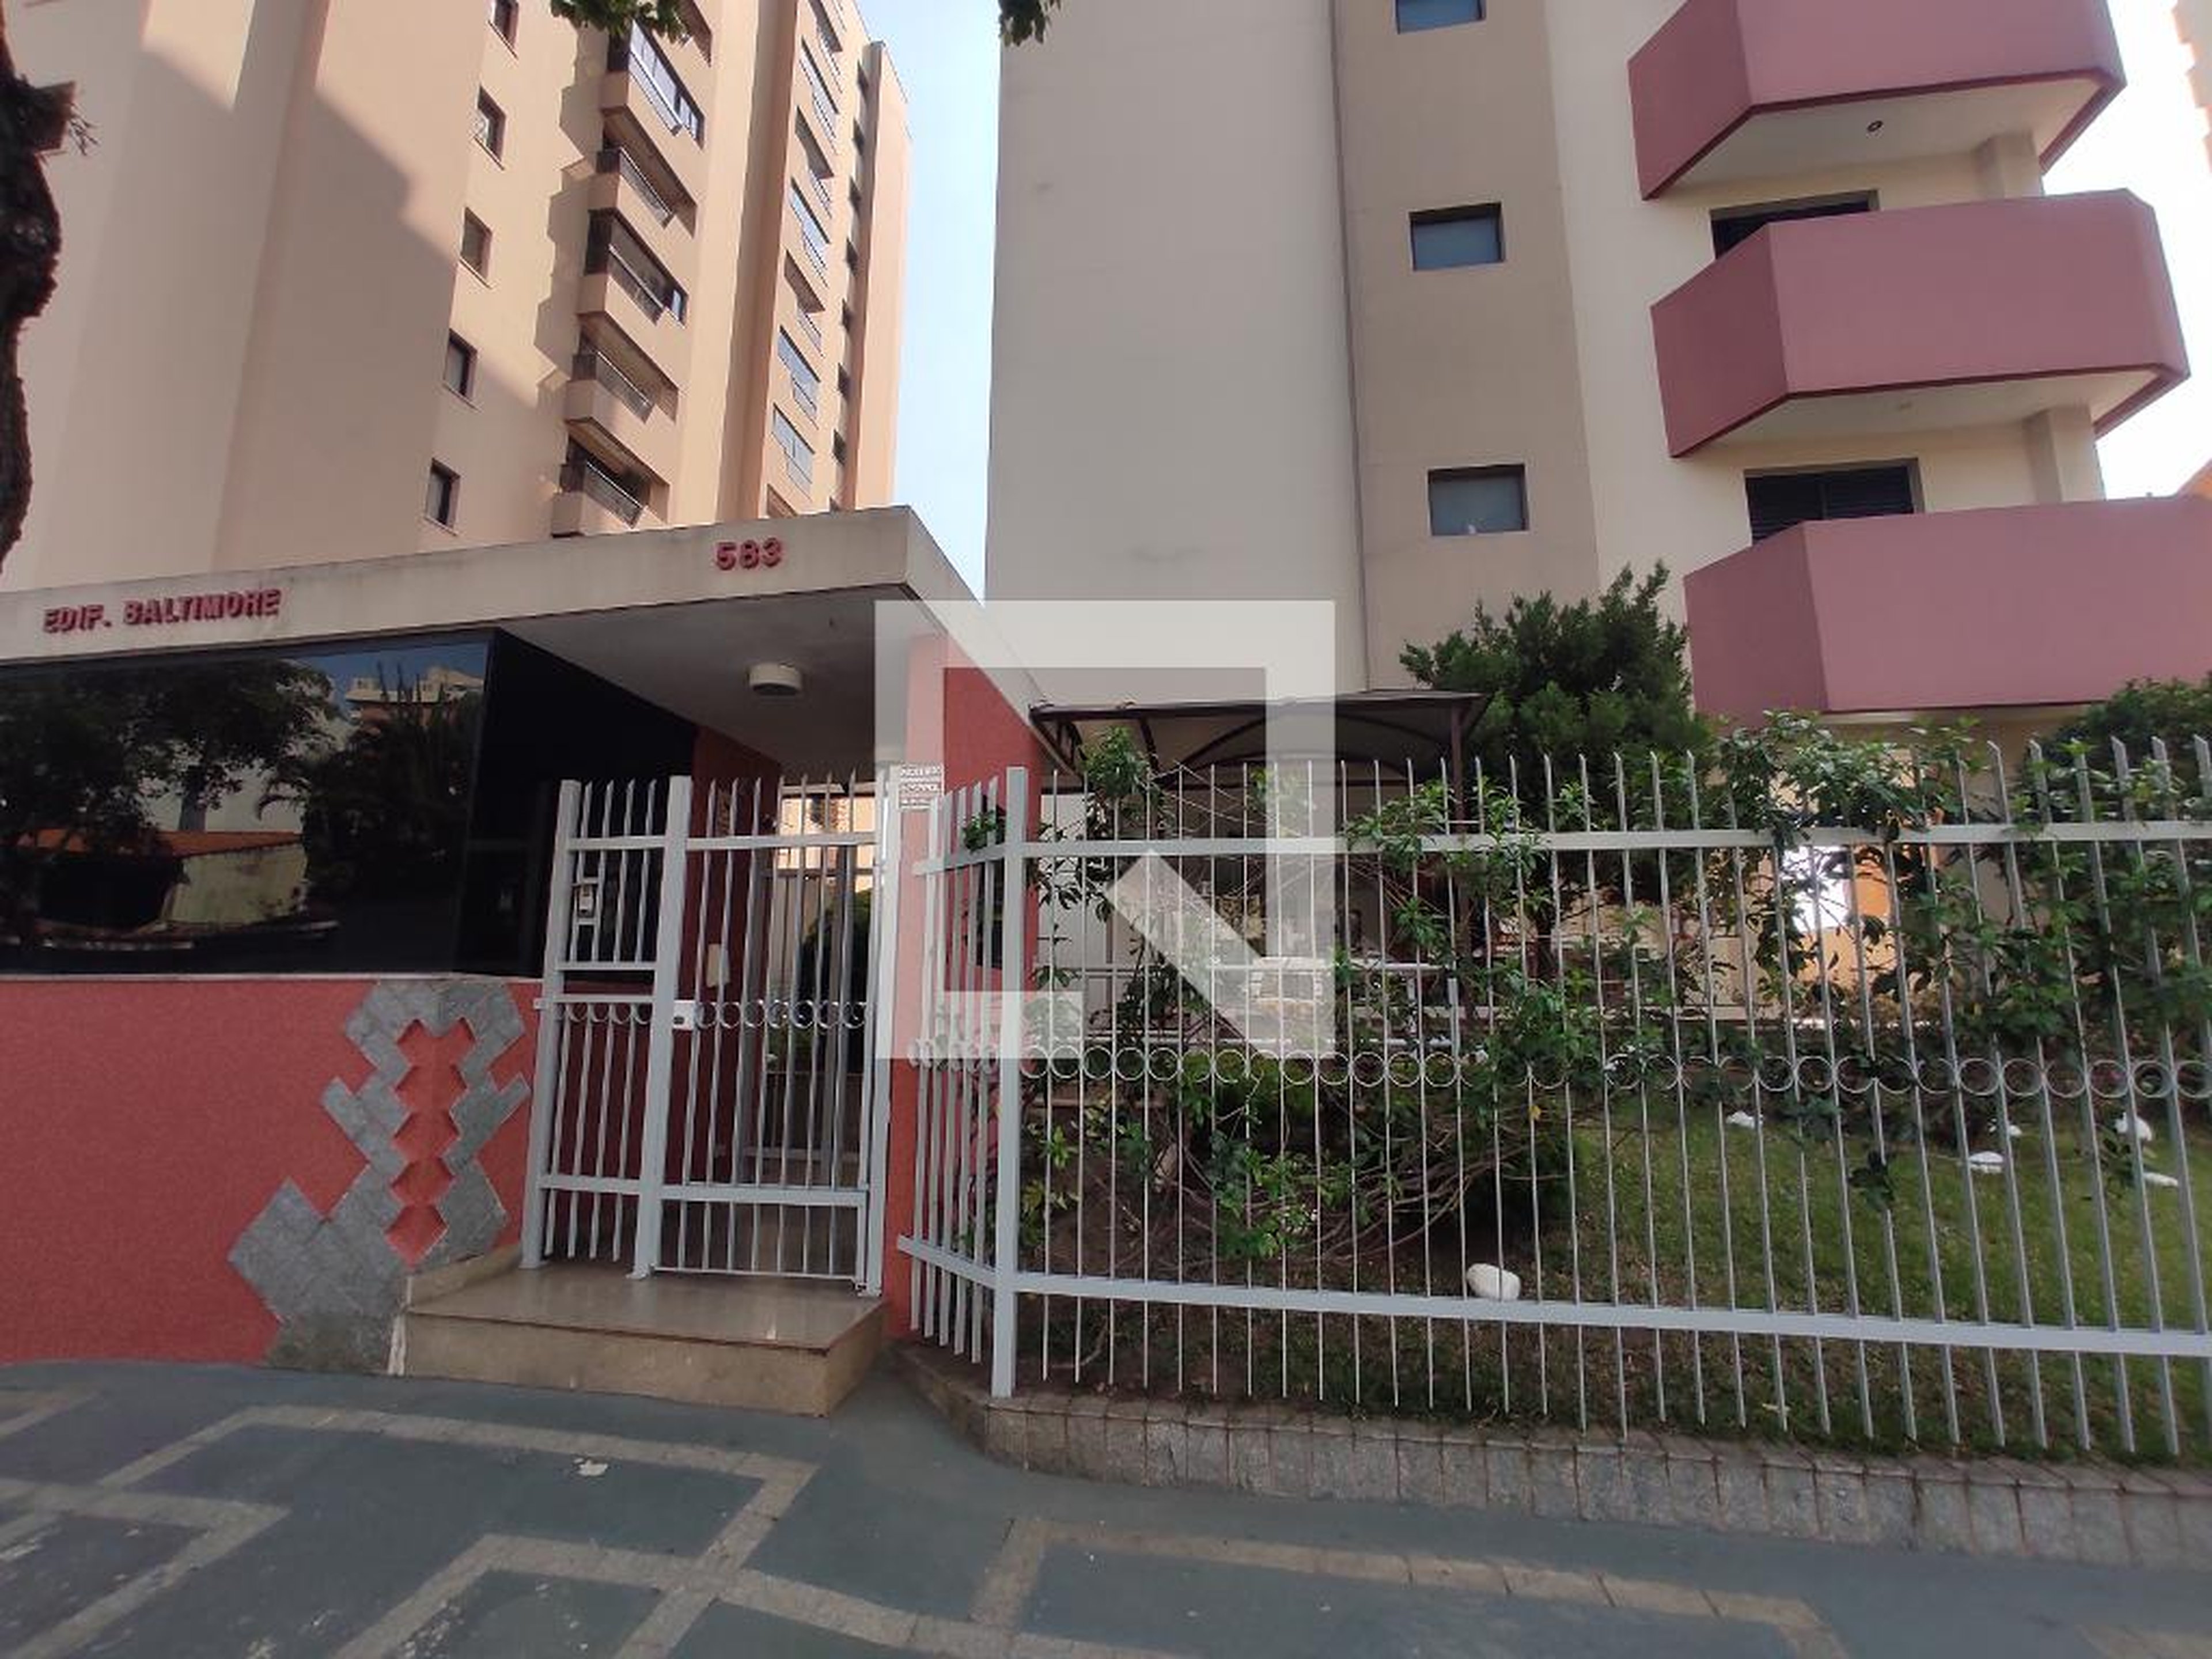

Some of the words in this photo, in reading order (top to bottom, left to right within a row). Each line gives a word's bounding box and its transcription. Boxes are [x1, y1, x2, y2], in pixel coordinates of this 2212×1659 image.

[716, 537, 782, 571] 583
[44, 604, 112, 634] EDIF.
[123, 588, 282, 626] BALTIMORE
